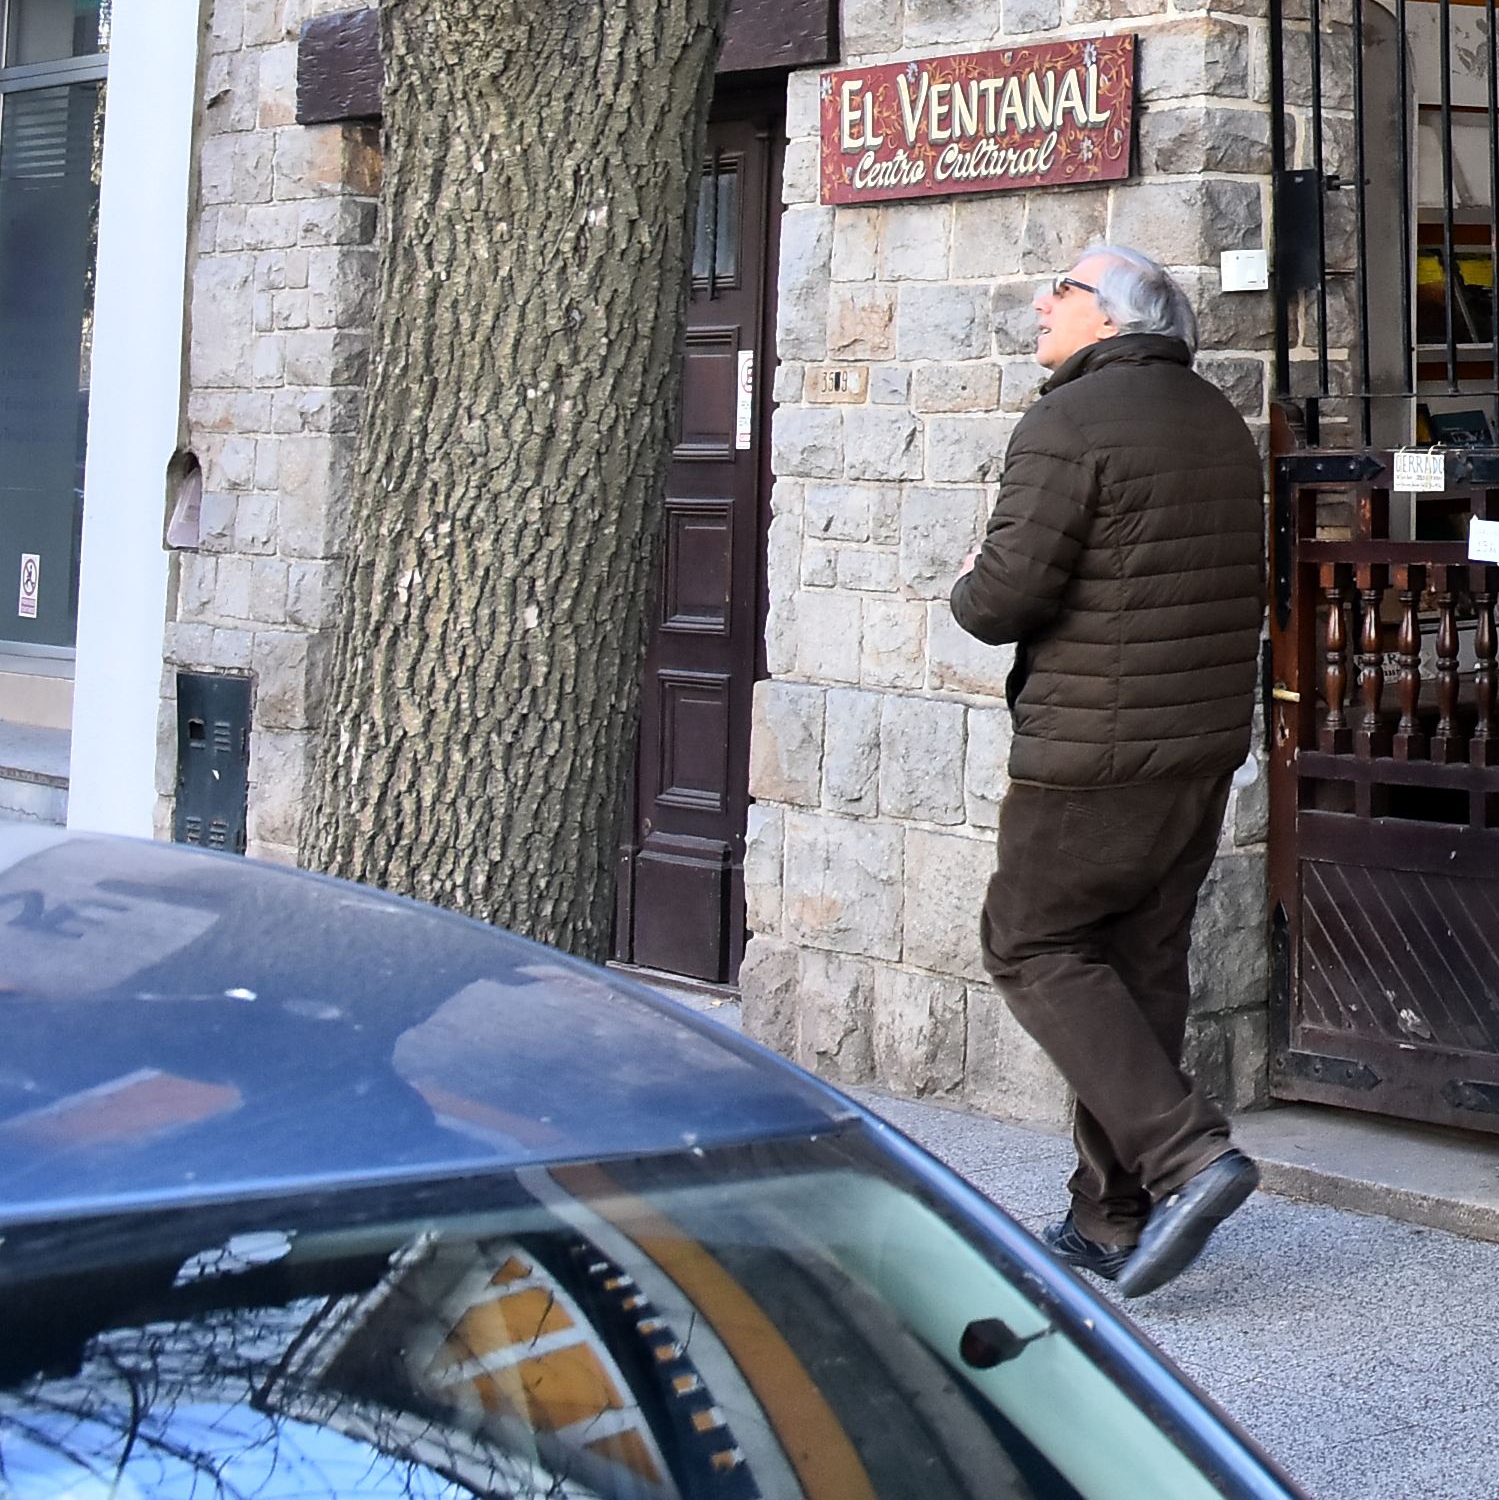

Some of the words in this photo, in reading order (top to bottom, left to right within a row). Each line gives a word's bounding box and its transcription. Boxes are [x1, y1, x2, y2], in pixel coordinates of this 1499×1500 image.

[841, 79, 883, 151] EL
[896, 64, 1111, 144] VENTANAL
[855, 149, 926, 190] Centro
[935, 131, 1057, 182] Cultural
